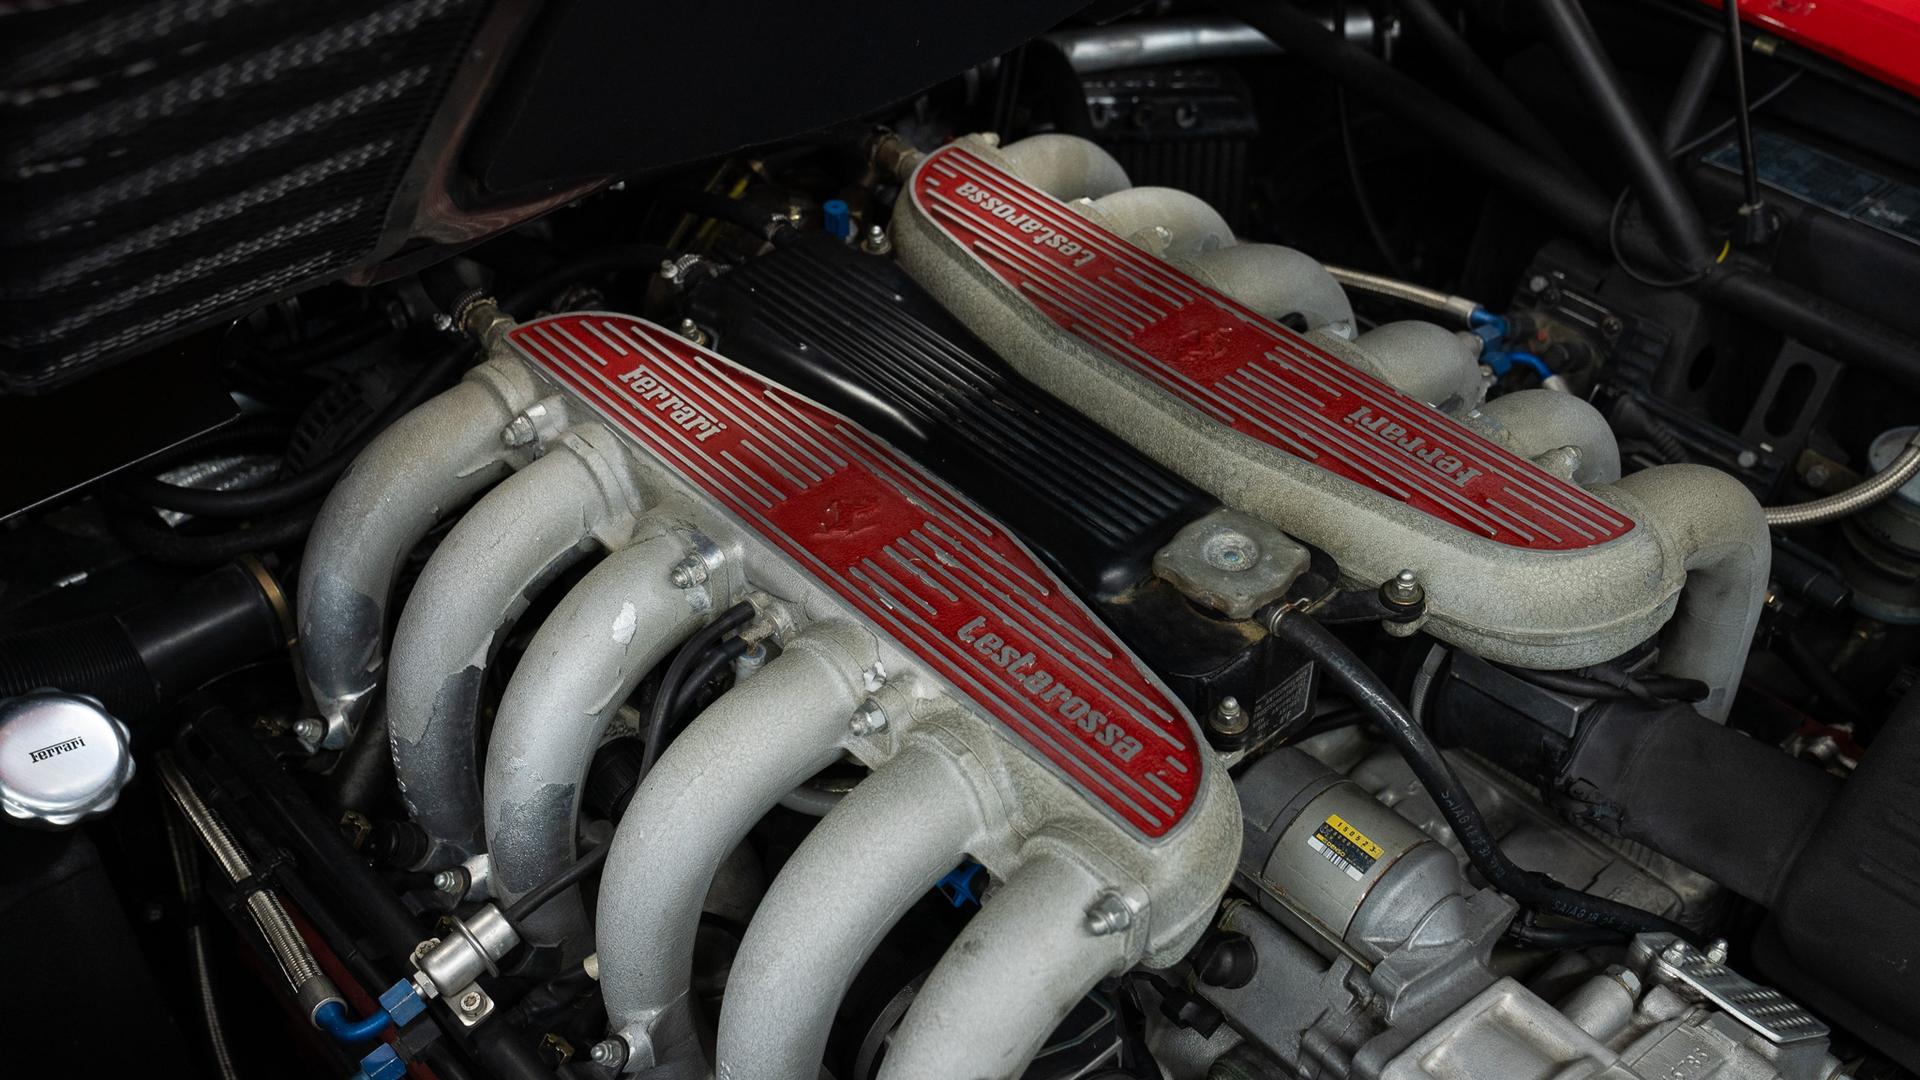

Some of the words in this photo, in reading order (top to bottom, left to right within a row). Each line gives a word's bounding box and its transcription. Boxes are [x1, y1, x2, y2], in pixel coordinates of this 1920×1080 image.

[617, 364, 728, 441] Ferrari
[1343, 406, 1483, 488] Ferrari
[29, 736, 86, 763] Ferrari
